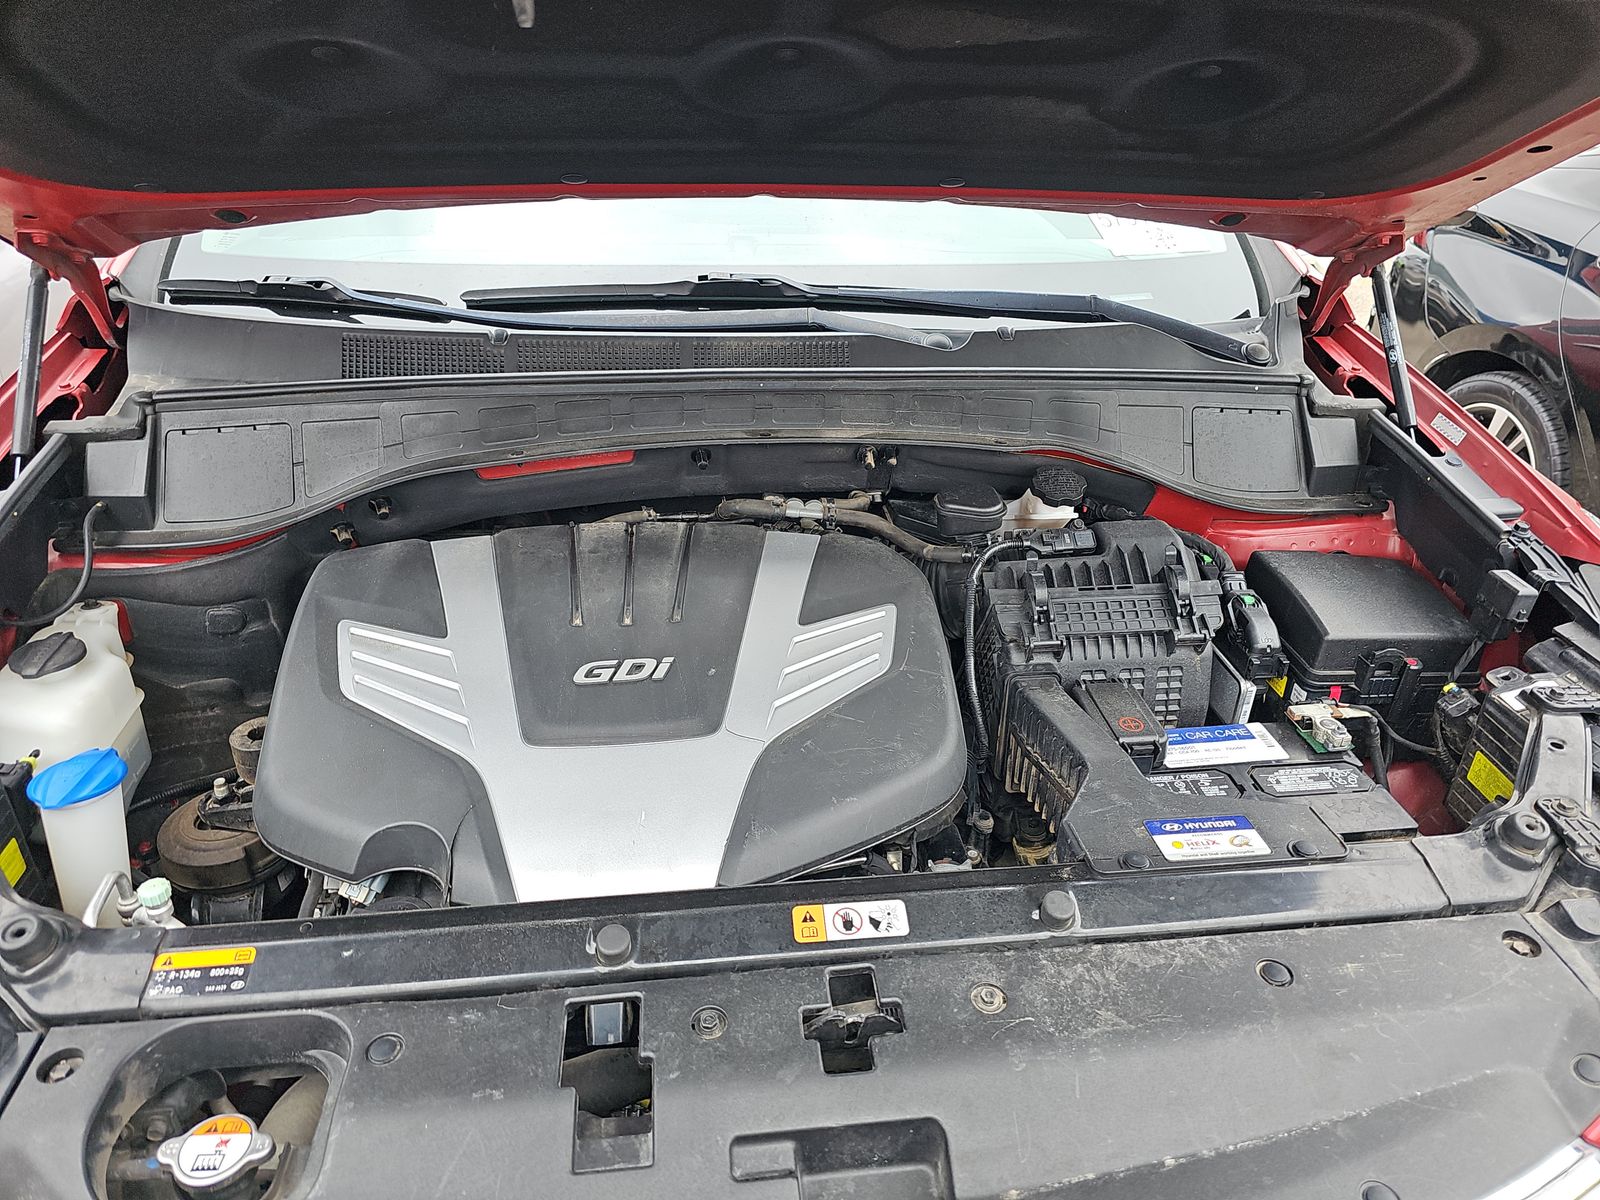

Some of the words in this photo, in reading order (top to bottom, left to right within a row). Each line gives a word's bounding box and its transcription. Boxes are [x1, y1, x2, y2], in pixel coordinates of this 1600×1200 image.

[573, 656, 675, 685] GDi
[1185, 731, 1213, 740] CAR
[1215, 728, 1251, 738] CARE
[1183, 820, 1237, 830] HYUNDAI
